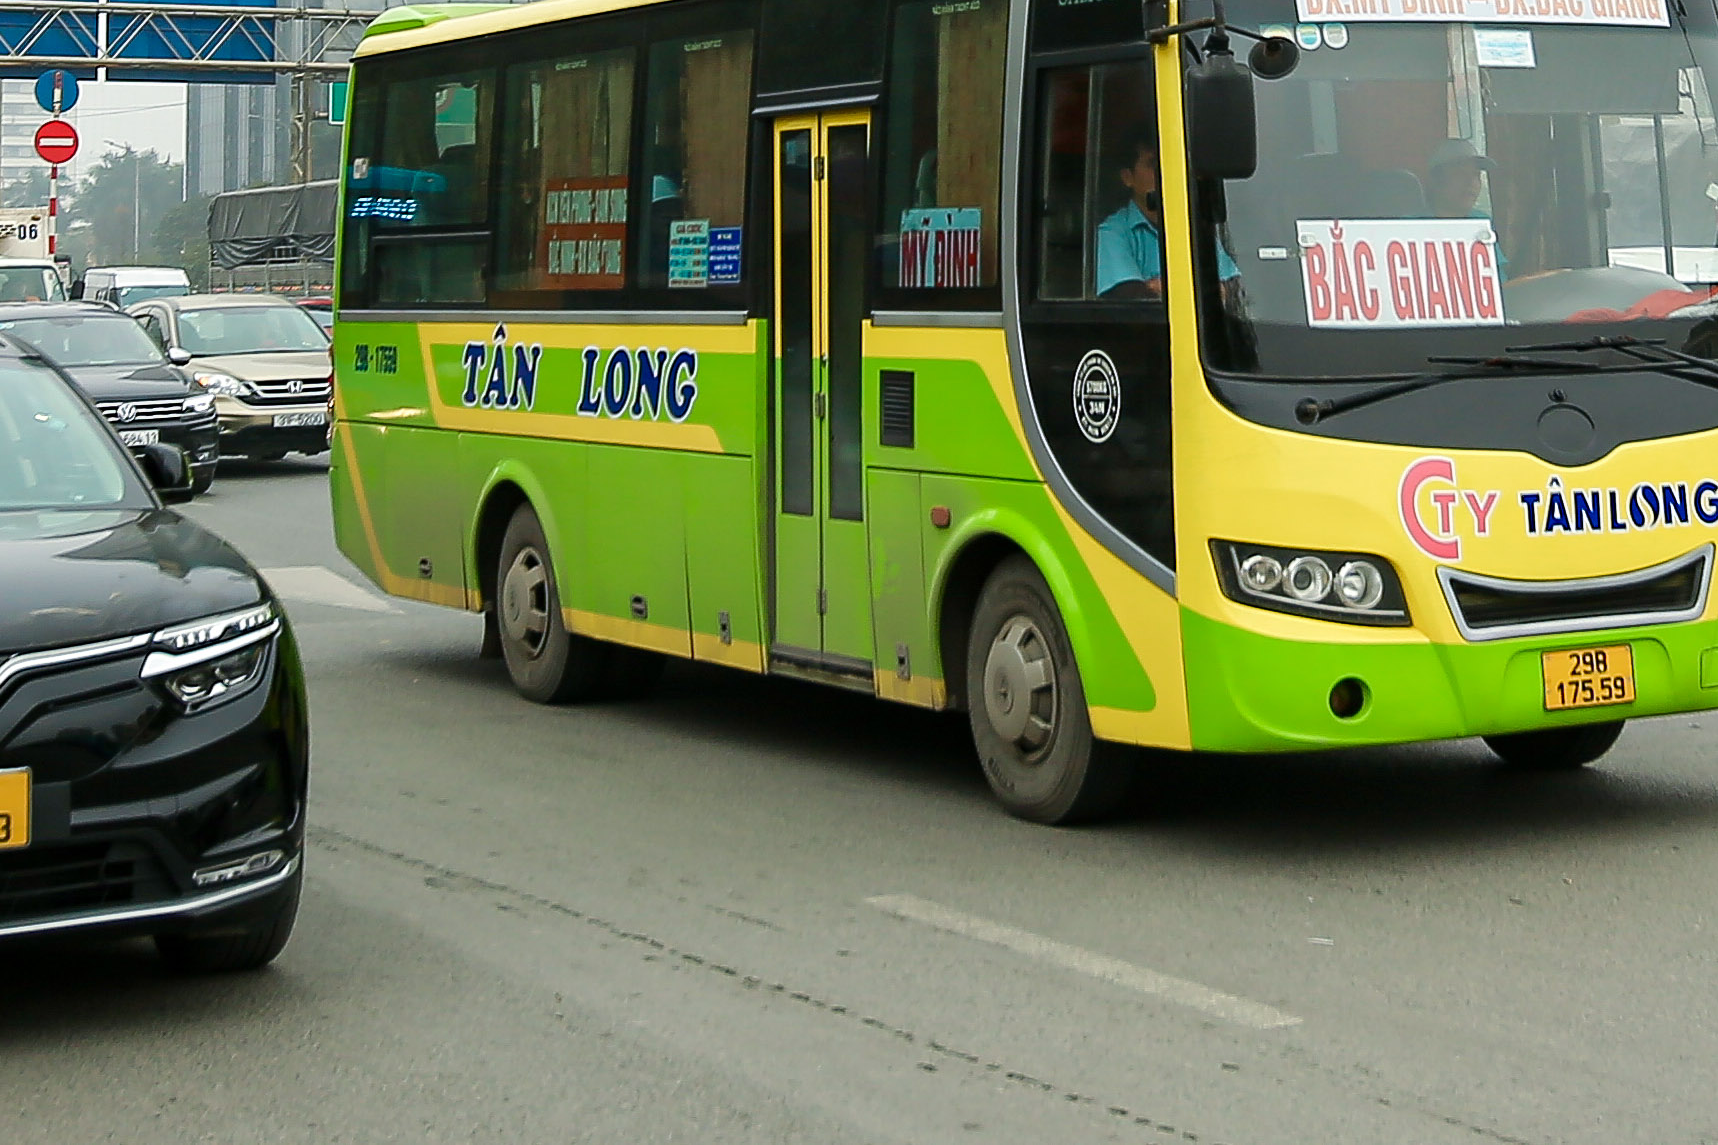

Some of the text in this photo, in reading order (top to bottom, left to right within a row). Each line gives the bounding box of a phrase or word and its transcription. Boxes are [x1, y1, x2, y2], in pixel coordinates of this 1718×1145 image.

[1306, 220, 1498, 320] BẮC GIANG
[463, 321, 698, 422] TÂN LONG
[1557, 676, 1627, 705] 175.59
[1569, 651, 1608, 676] 29B
